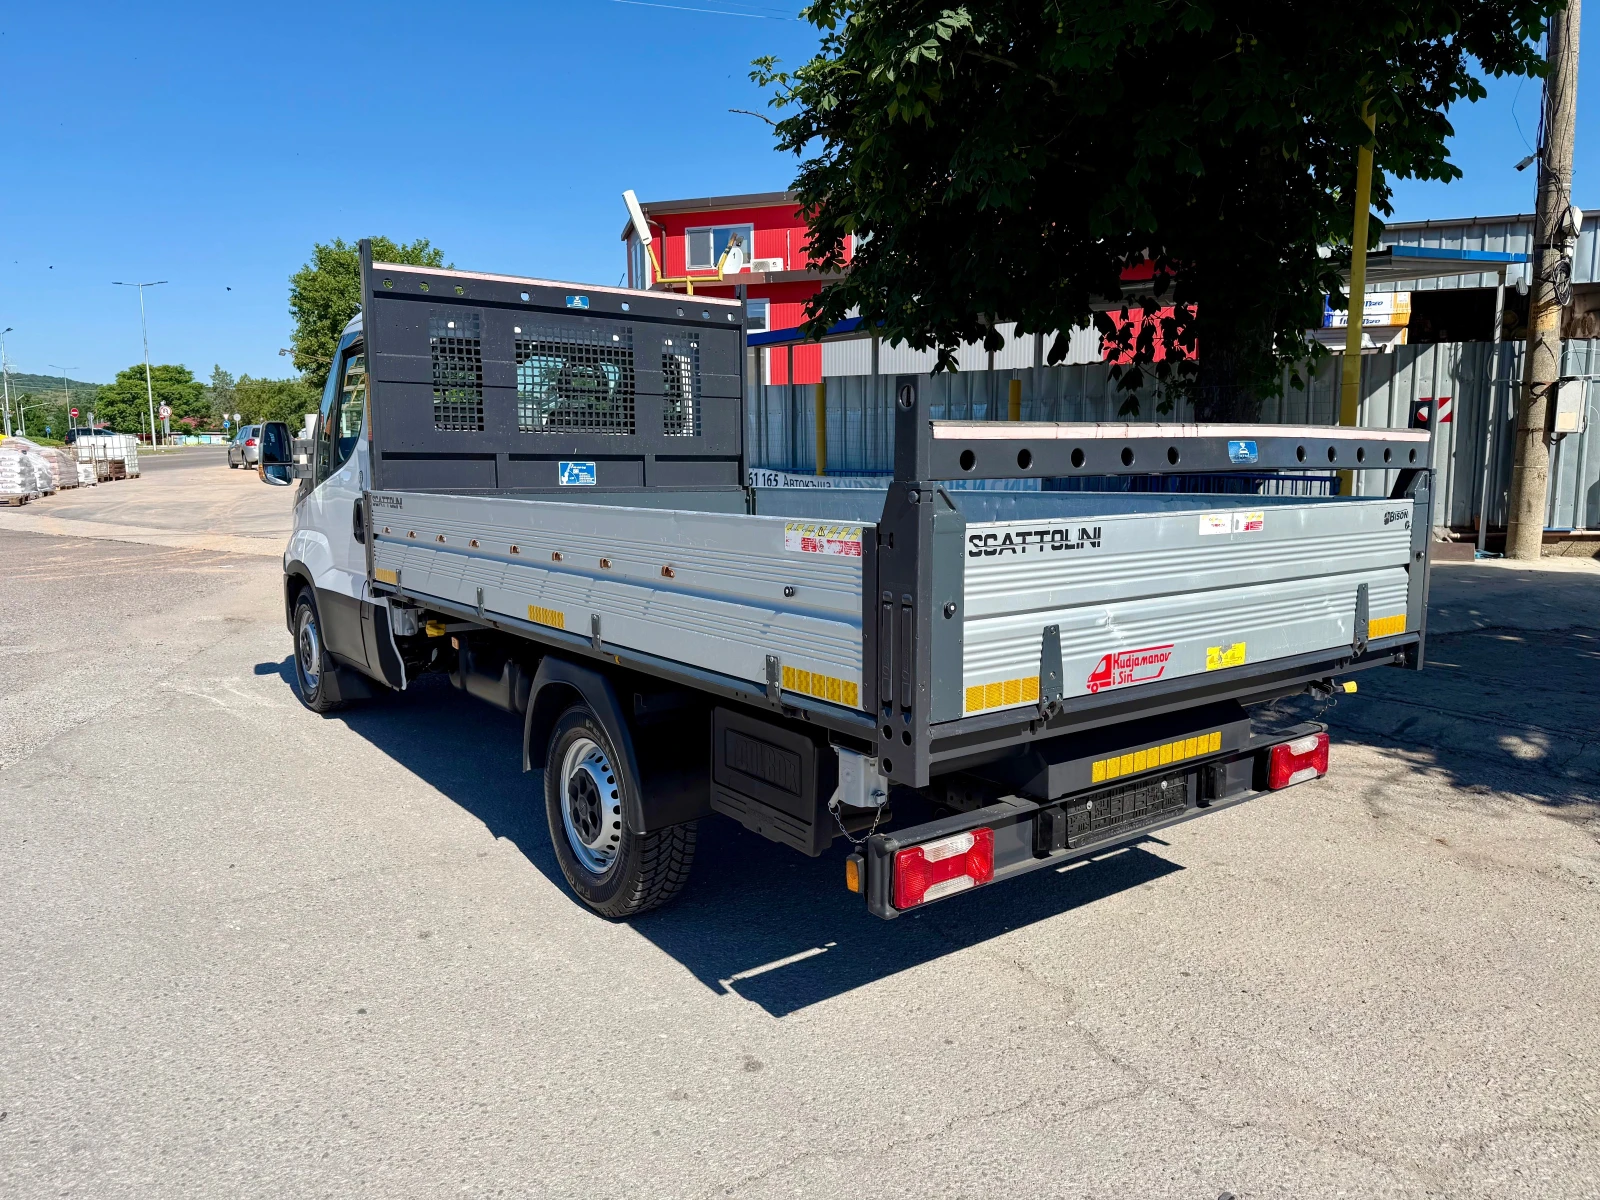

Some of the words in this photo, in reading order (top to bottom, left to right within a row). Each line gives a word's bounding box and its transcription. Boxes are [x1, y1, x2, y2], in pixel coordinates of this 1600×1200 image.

[762, 472, 779, 487] 165
[968, 526, 1102, 558] SCATTOLINI
[1112, 651, 1172, 672] Kudjamanov
[1118, 670, 1133, 685] Sin
